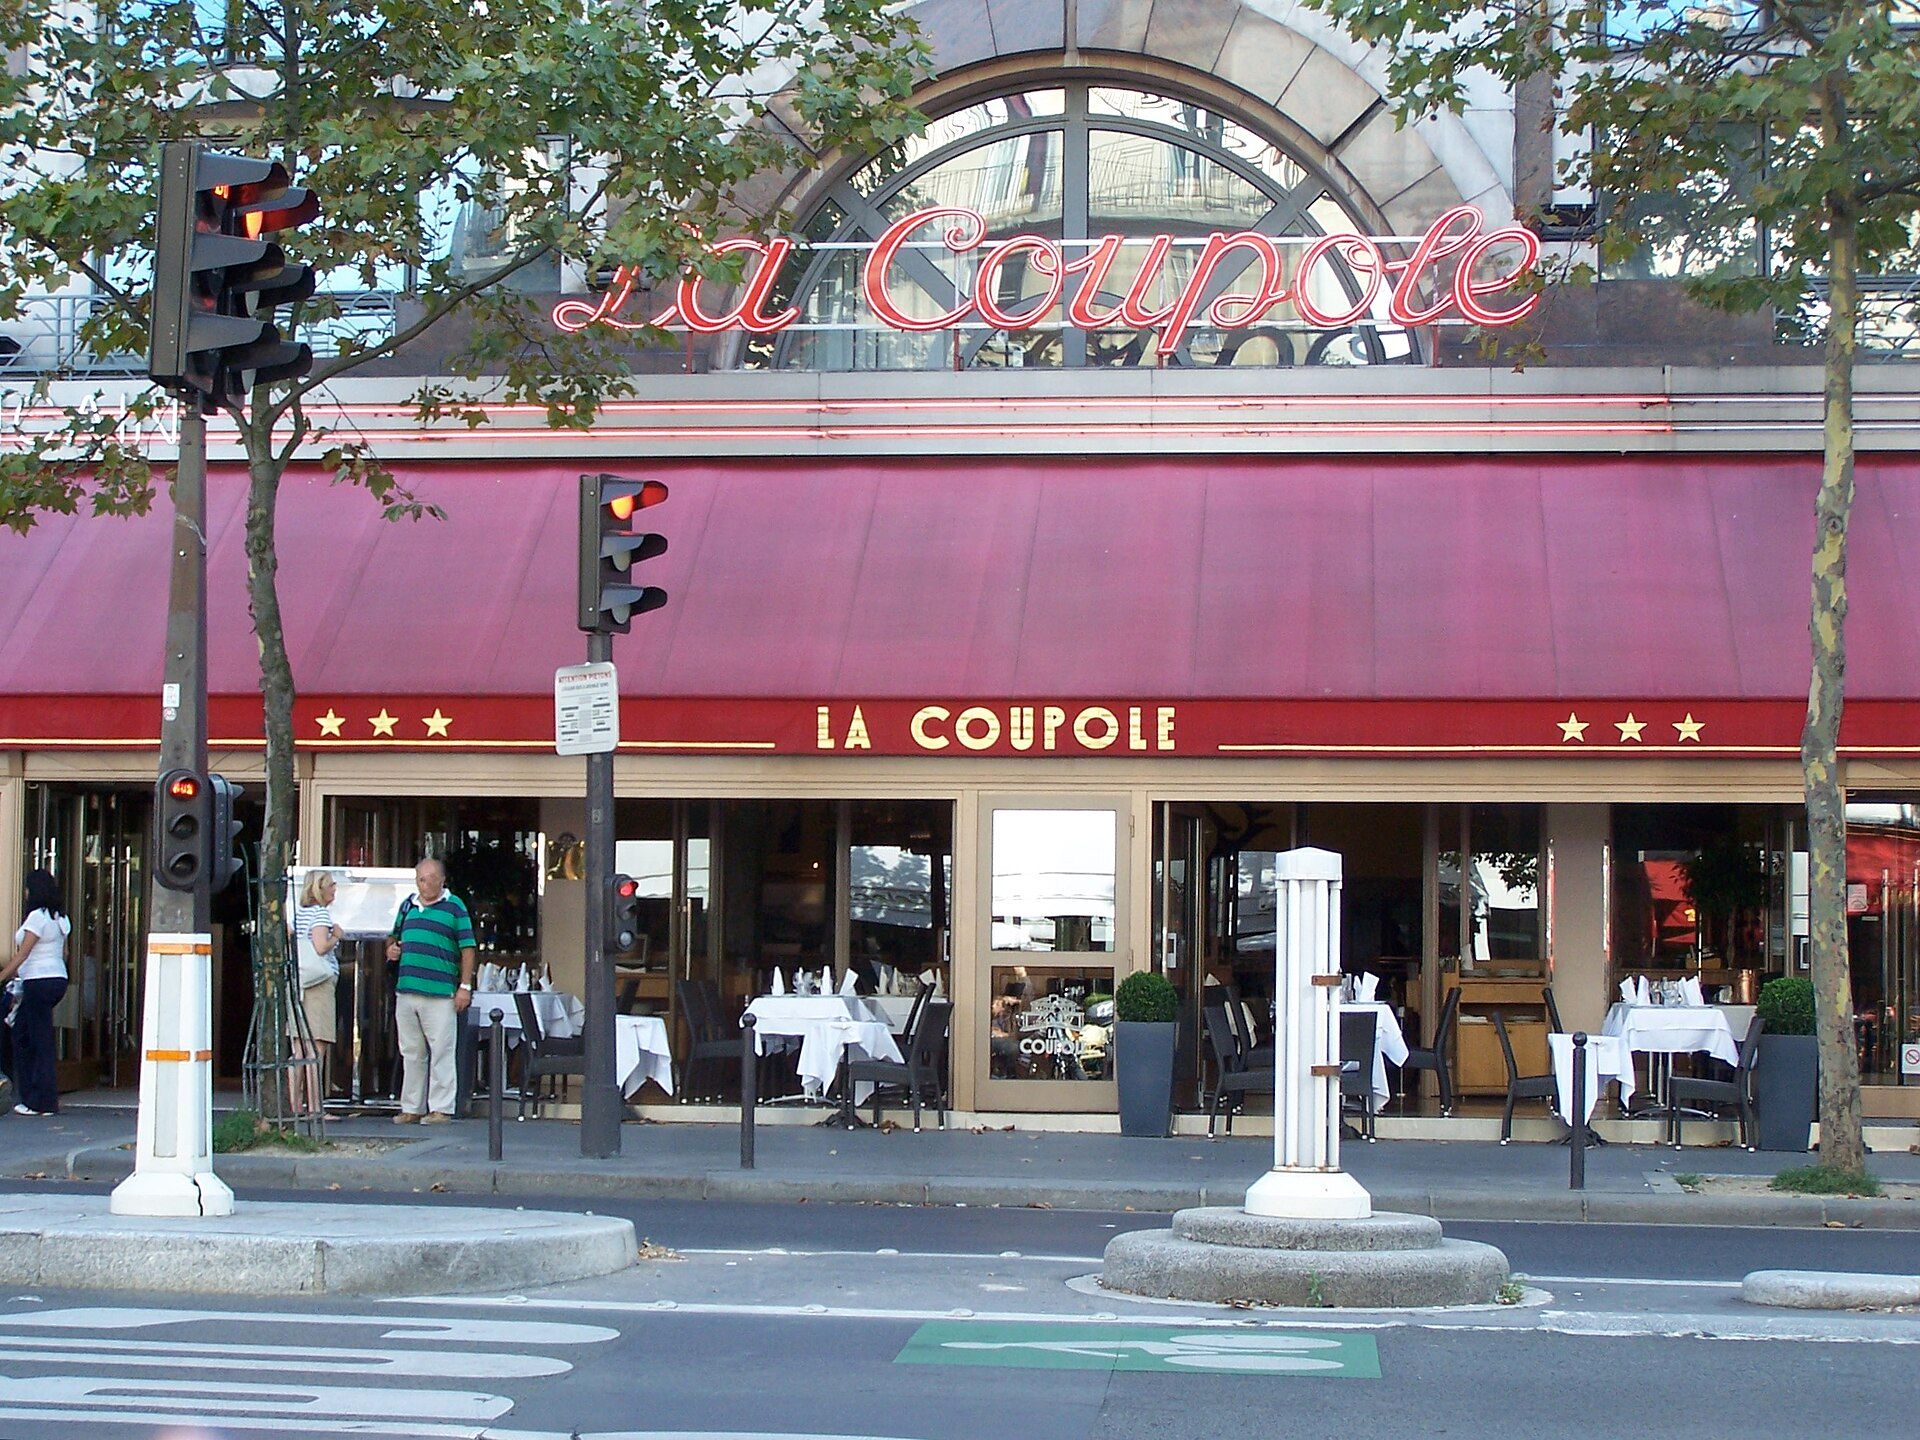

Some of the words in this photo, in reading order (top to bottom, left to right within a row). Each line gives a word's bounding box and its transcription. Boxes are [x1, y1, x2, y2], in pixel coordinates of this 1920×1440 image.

[863, 205, 1541, 355] Coupole
[816, 704, 872, 750] LA
[910, 706, 1176, 750] COUPOLE
